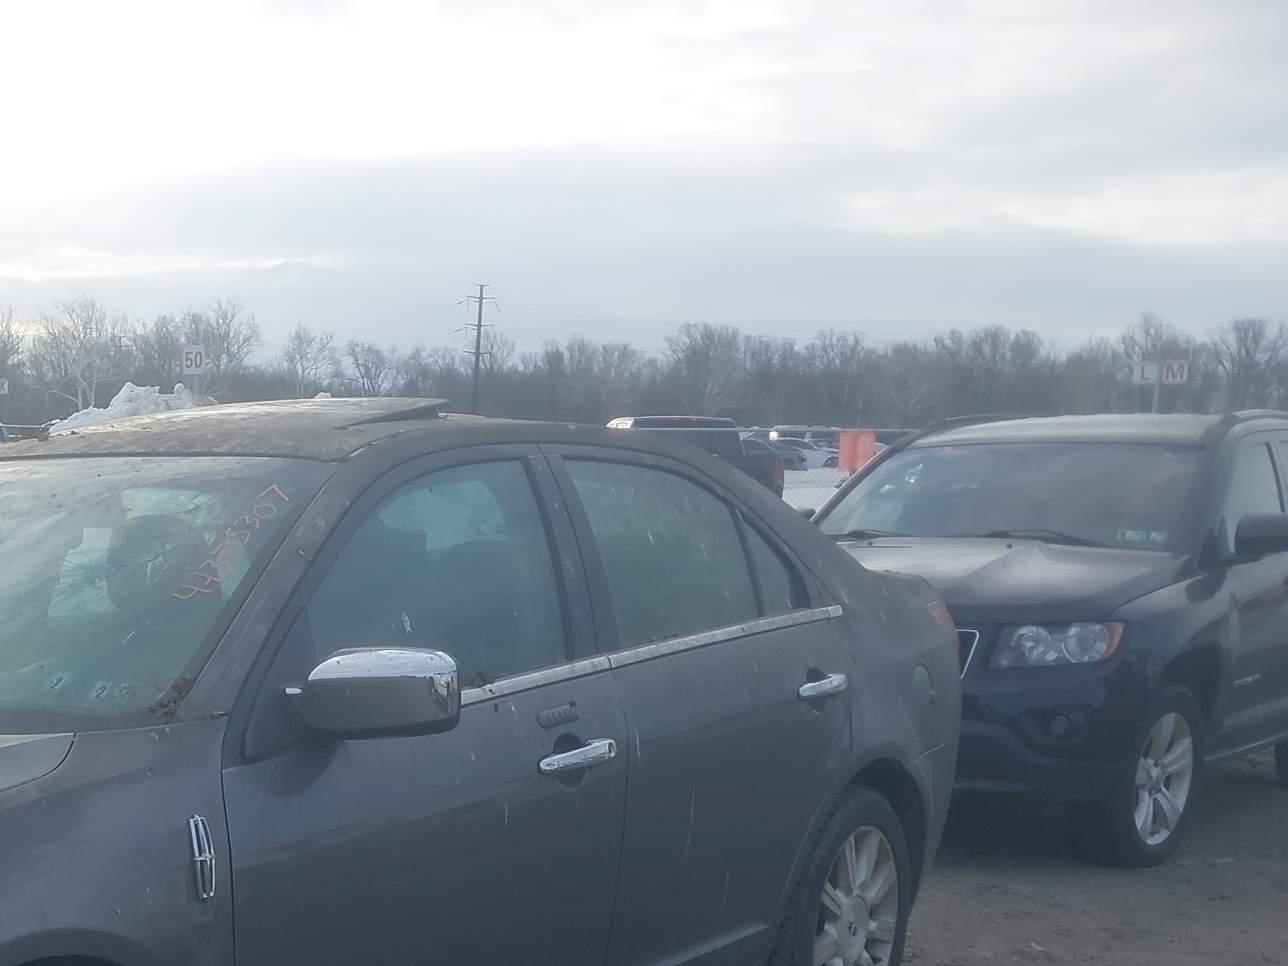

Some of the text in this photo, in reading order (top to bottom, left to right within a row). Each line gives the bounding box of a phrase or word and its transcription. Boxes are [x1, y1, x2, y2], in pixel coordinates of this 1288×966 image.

[184, 351, 202, 369] 50
[1139, 364, 1151, 381] L
[1164, 363, 1186, 381] M
